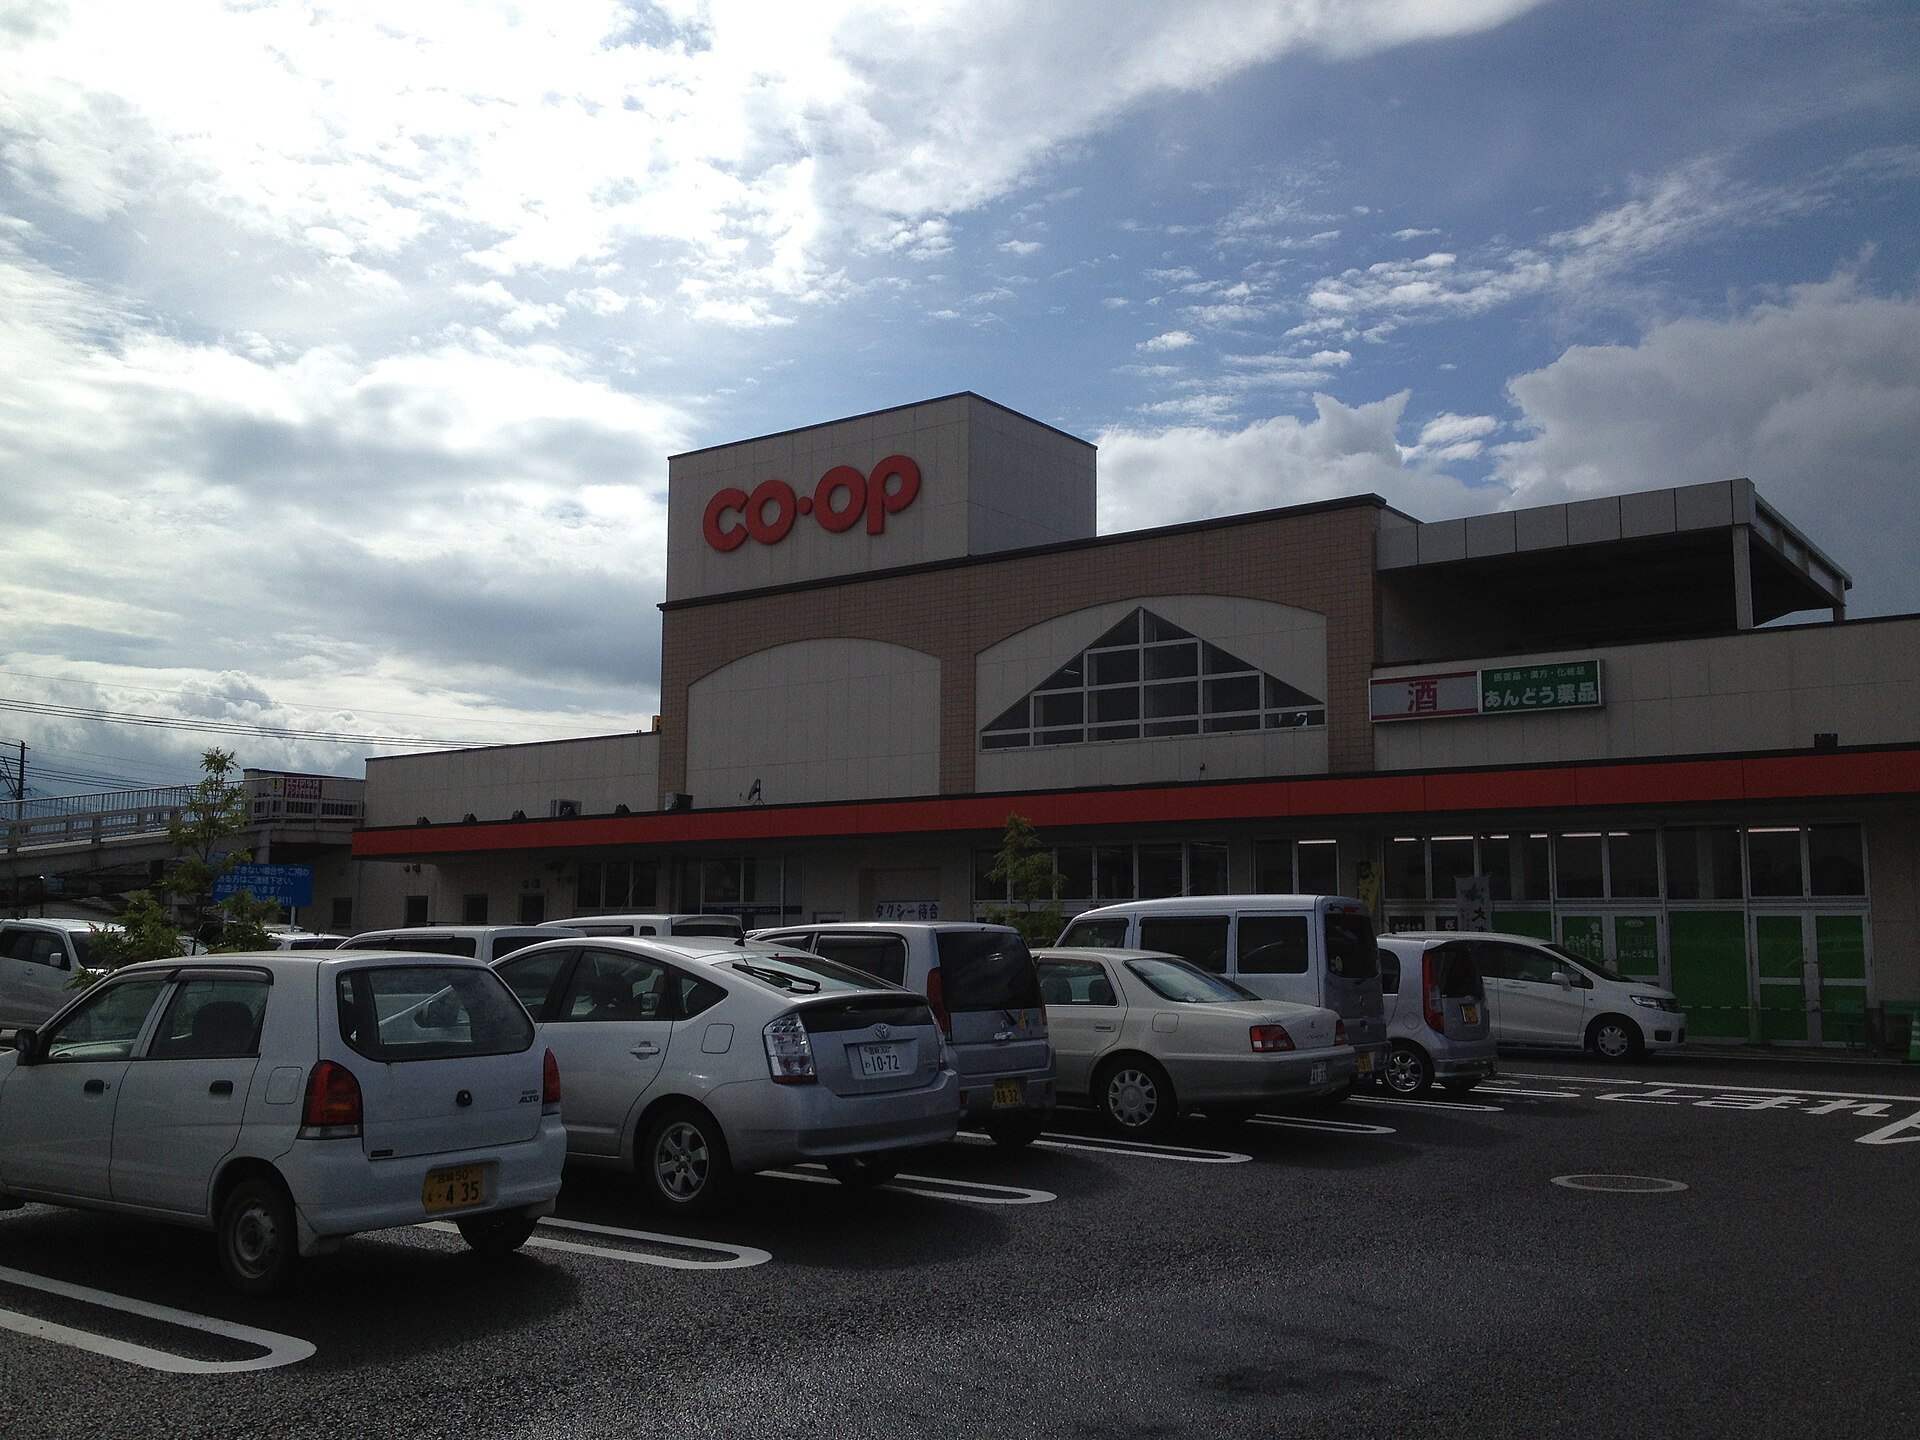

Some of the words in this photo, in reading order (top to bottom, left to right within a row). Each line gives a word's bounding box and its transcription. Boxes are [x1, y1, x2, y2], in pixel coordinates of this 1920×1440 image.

[1408, 680, 1438, 711] 酒
[1485, 682, 1597, 708] あんどう薬品
[519, 1095, 539, 1104] ALTO
[1595, 1088, 1893, 1118] とまれ
